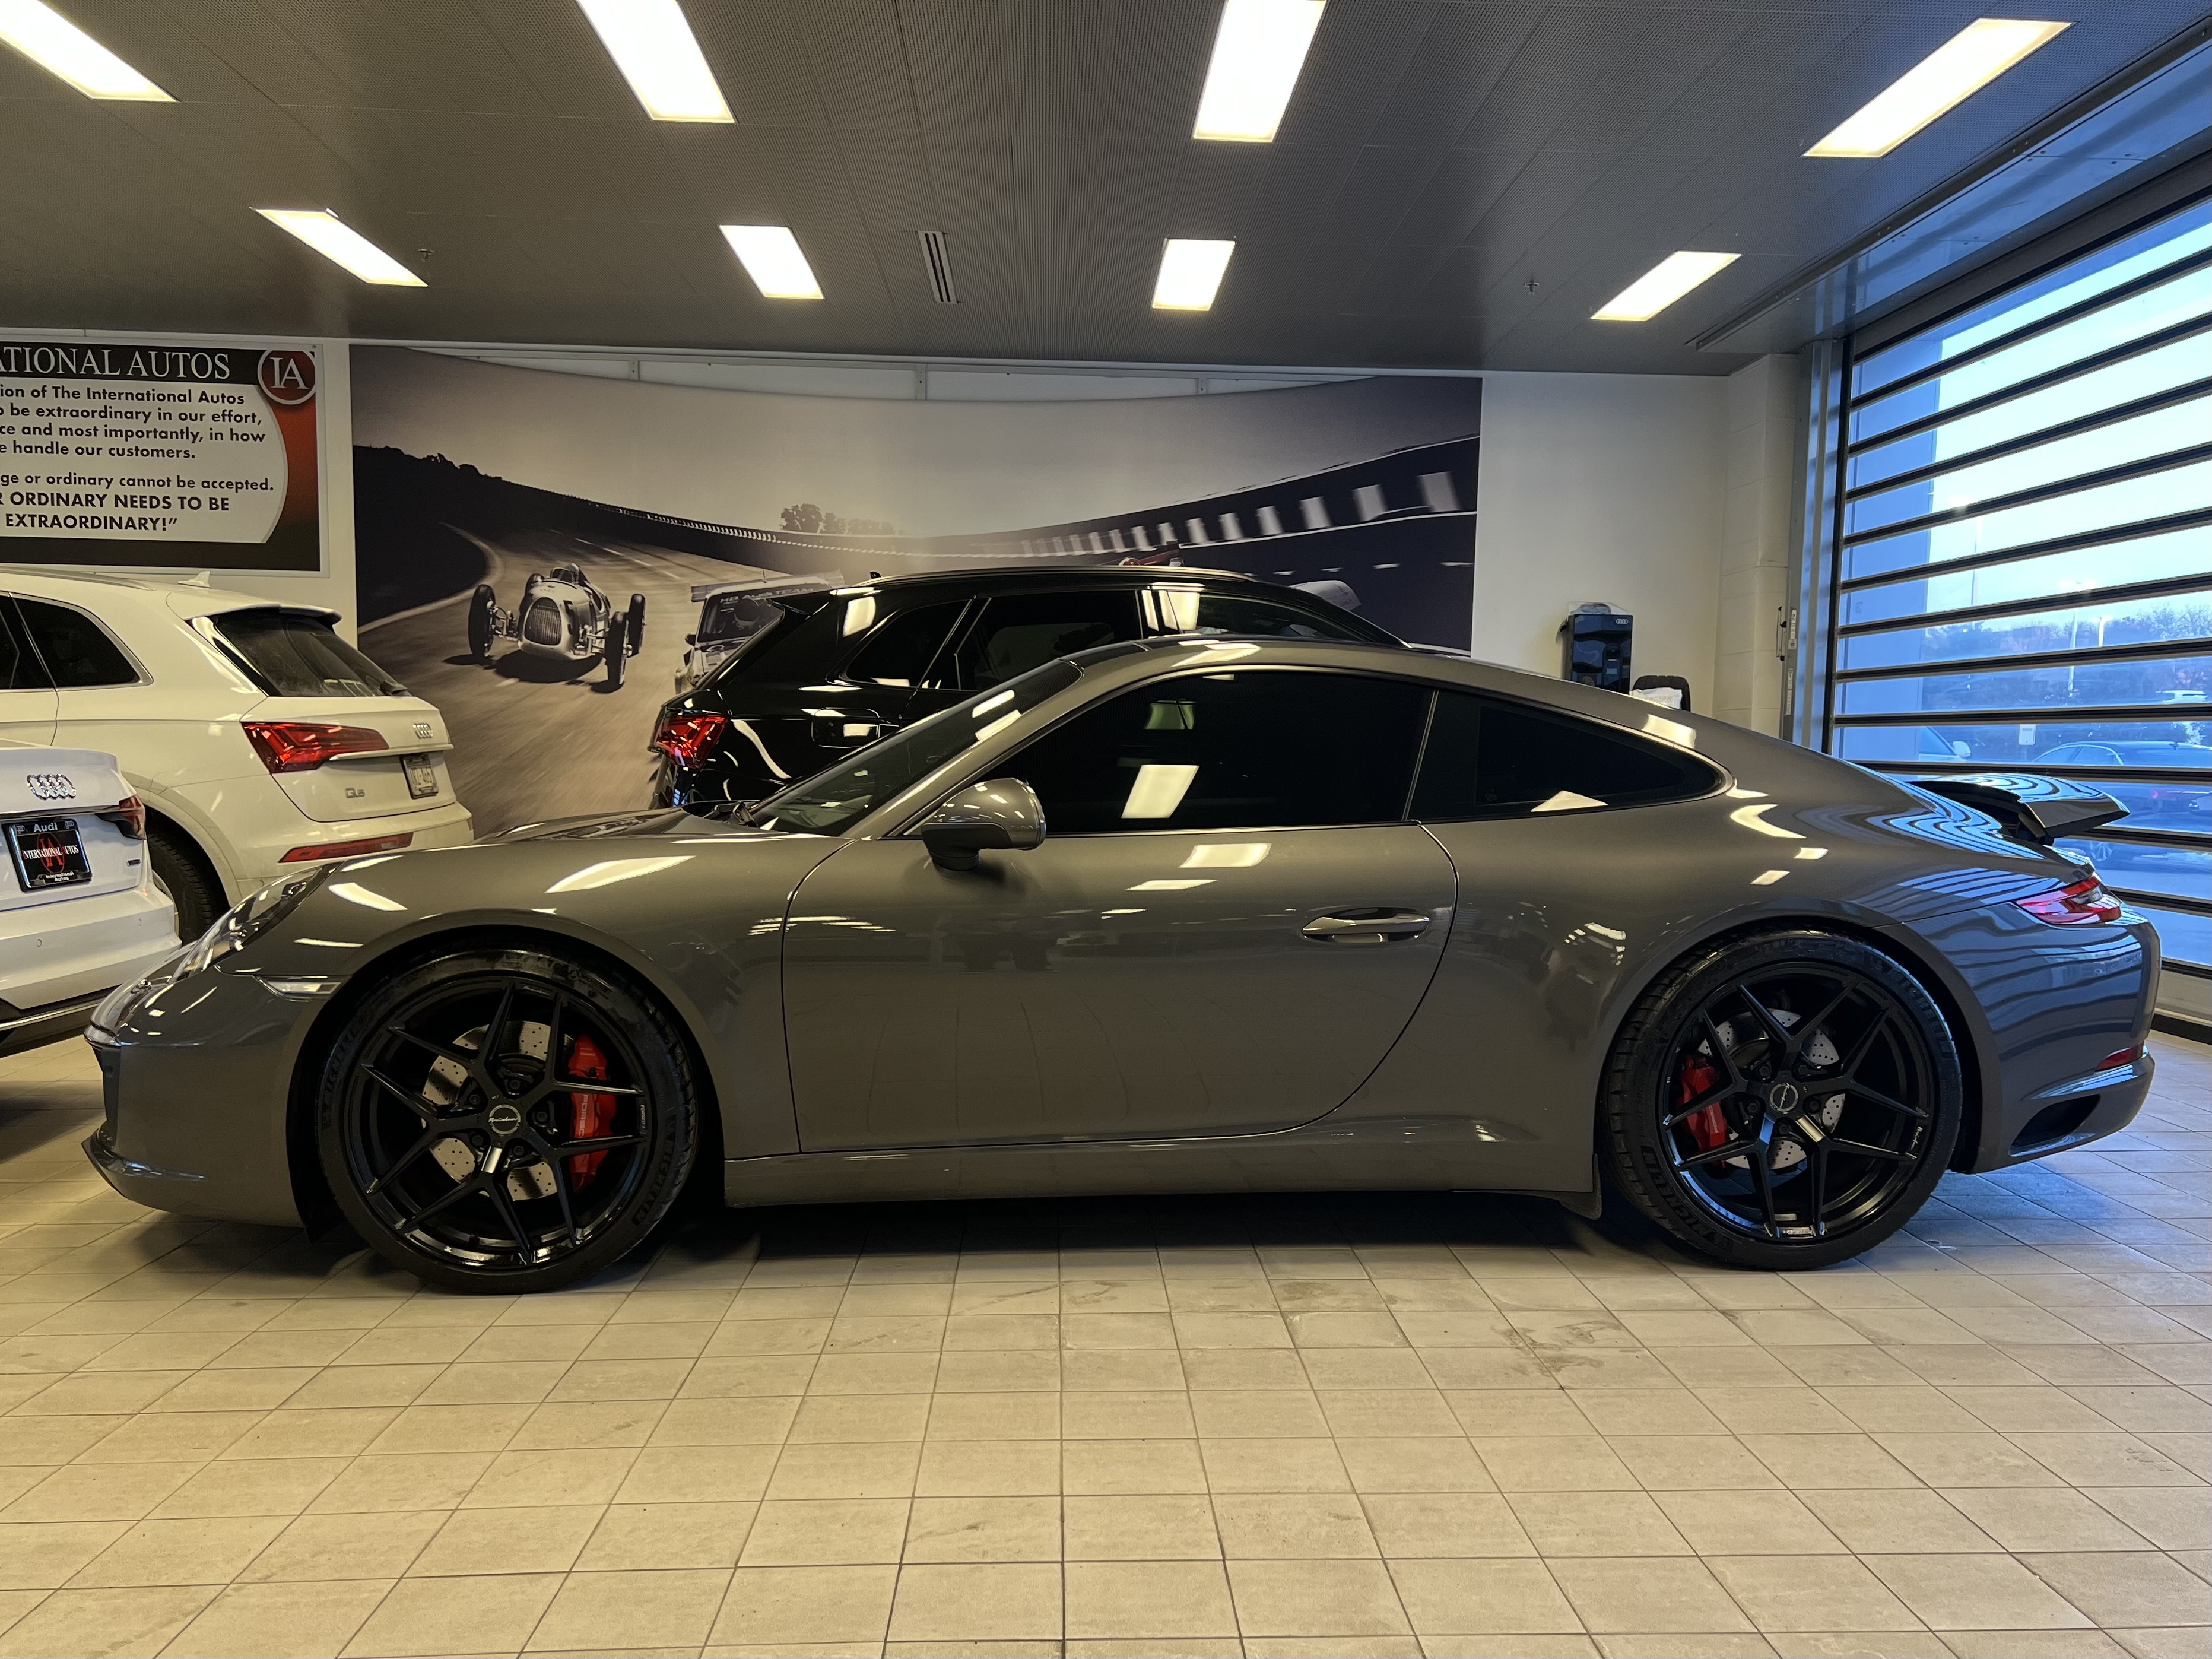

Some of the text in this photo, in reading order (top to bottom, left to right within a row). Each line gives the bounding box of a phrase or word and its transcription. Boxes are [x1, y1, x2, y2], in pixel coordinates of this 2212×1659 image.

[125, 350, 230, 380] AUTOS
[270, 356, 309, 390] IA
[0, 384, 245, 404] ion of The International Autos
[10, 402, 30, 416] be
[36, 405, 151, 424] extraordinary
[158, 407, 172, 421] in
[179, 410, 206, 422] our
[212, 409, 262, 426] effort,
[21, 422, 52, 436] and
[59, 426, 99, 437] most
[104, 424, 204, 444] importantly,
[210, 427, 224, 441] in
[230, 428, 266, 442] how
[13, 440, 69, 455] handle
[75, 446, 103, 456] our
[109, 446, 195, 459] customers.
[1, 472, 274, 493] ge or ordinary cannot be accepted.
[10, 491, 107, 507] ORDINARY
[115, 494, 172, 509] NEEDS
[178, 496, 202, 510] TO
[209, 497, 229, 511] BE
[6, 513, 177, 531] EXTRAORDINARY!"
[345, 787, 365, 798] Q5
[34, 822, 58, 833] Audi
[22, 844, 80, 860] INTERNATIONAL AUTOS
[578, 1094, 589, 1138] PORSC
